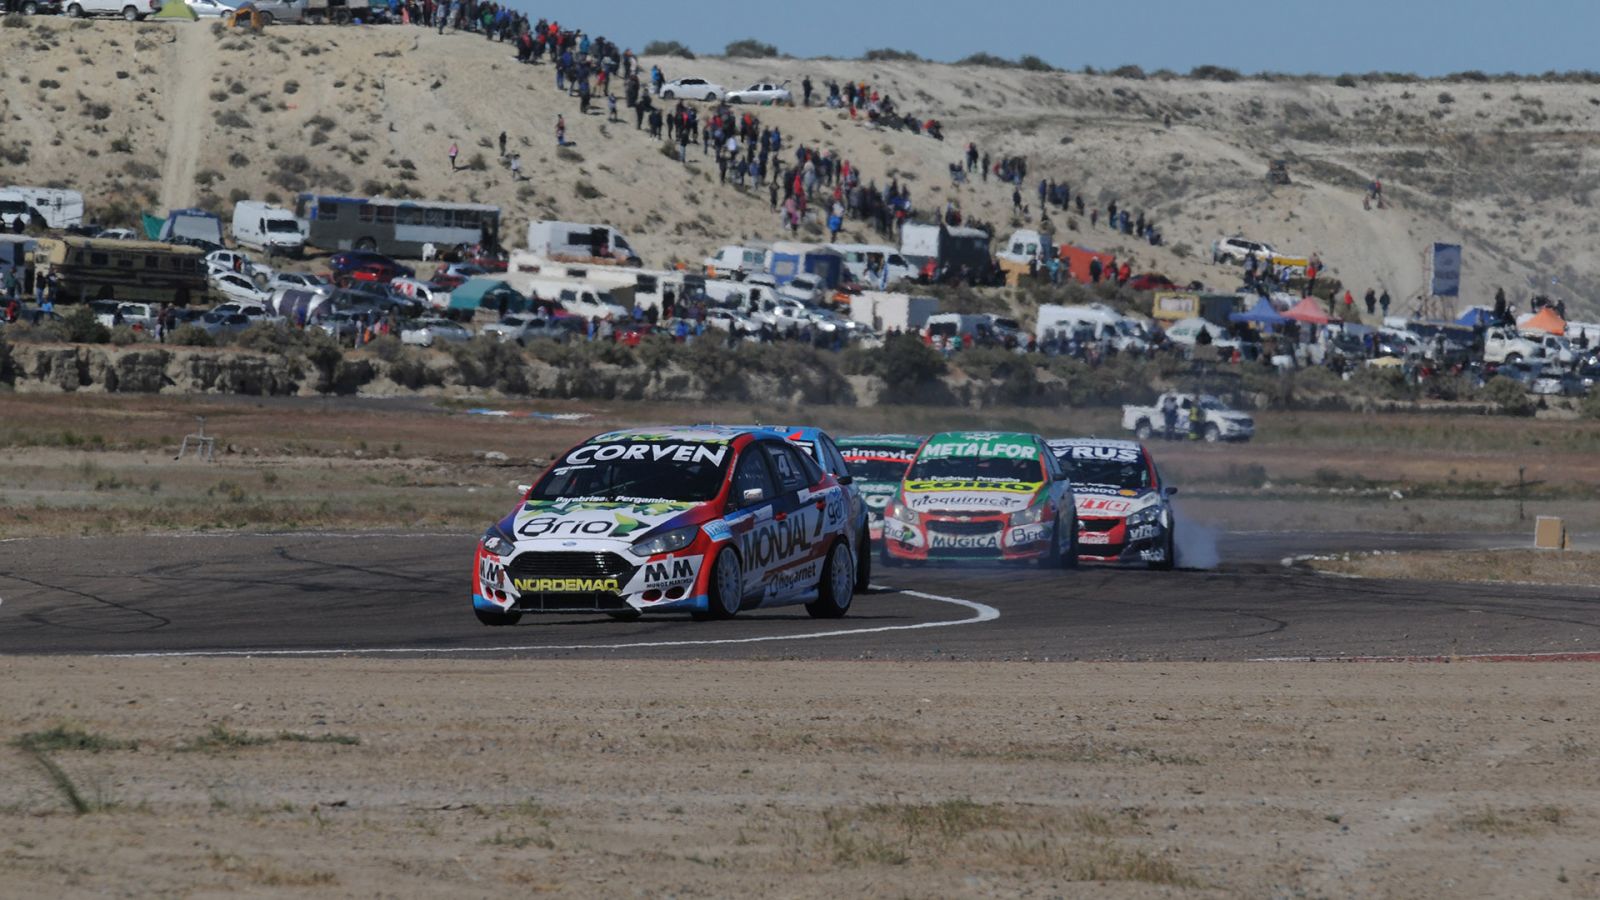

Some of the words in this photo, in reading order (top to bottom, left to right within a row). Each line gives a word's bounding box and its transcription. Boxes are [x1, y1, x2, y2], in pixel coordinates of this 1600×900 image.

[566, 444, 728, 467] CORVEN
[923, 443, 1036, 459] METALFOR
[1072, 446, 1138, 460] RUS
[778, 454, 791, 477] 4
[517, 517, 613, 537] Brio
[741, 512, 811, 574] MONDIAL
[932, 535, 997, 548] MUGICA
[514, 578, 619, 596] NORDEMAQ
